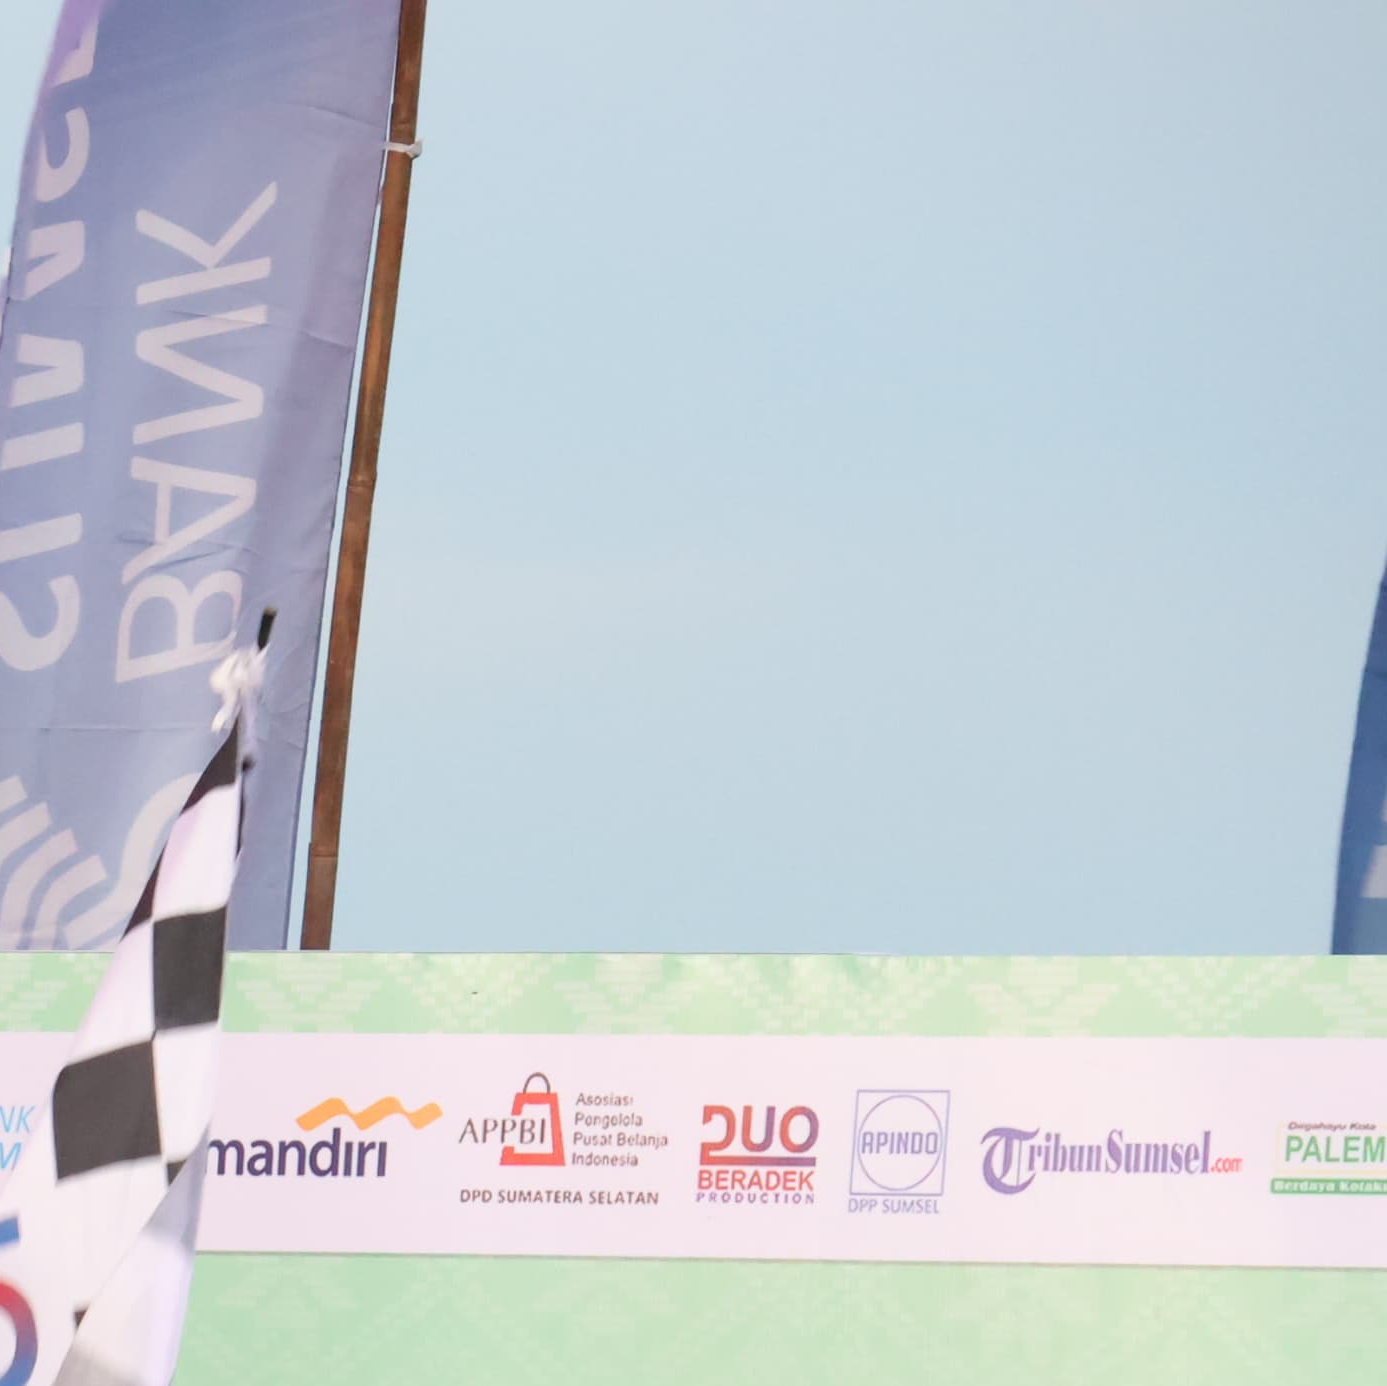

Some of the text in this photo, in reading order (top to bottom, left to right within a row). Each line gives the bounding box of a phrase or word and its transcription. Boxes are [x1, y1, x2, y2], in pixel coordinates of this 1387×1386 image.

[575, 1093, 634, 1107] Asosiasi
[574, 1112, 643, 1129] Pengelola
[458, 1118, 547, 1145] APPBI
[573, 1131, 668, 1148] Pusat Belanja
[700, 1105, 819, 1166] DUO
[861, 1131, 939, 1155] APINDO
[571, 1151, 639, 1168] Indonesia
[697, 1169, 815, 1192] BERADEK
[1273, 1179, 1335, 1194] Berdaya
[460, 1188, 659, 1205] DPD SUMATERA SELATAN
[696, 1192, 815, 1204] PRODUCTION
[847, 1198, 940, 1215] DPP SUMSEL
